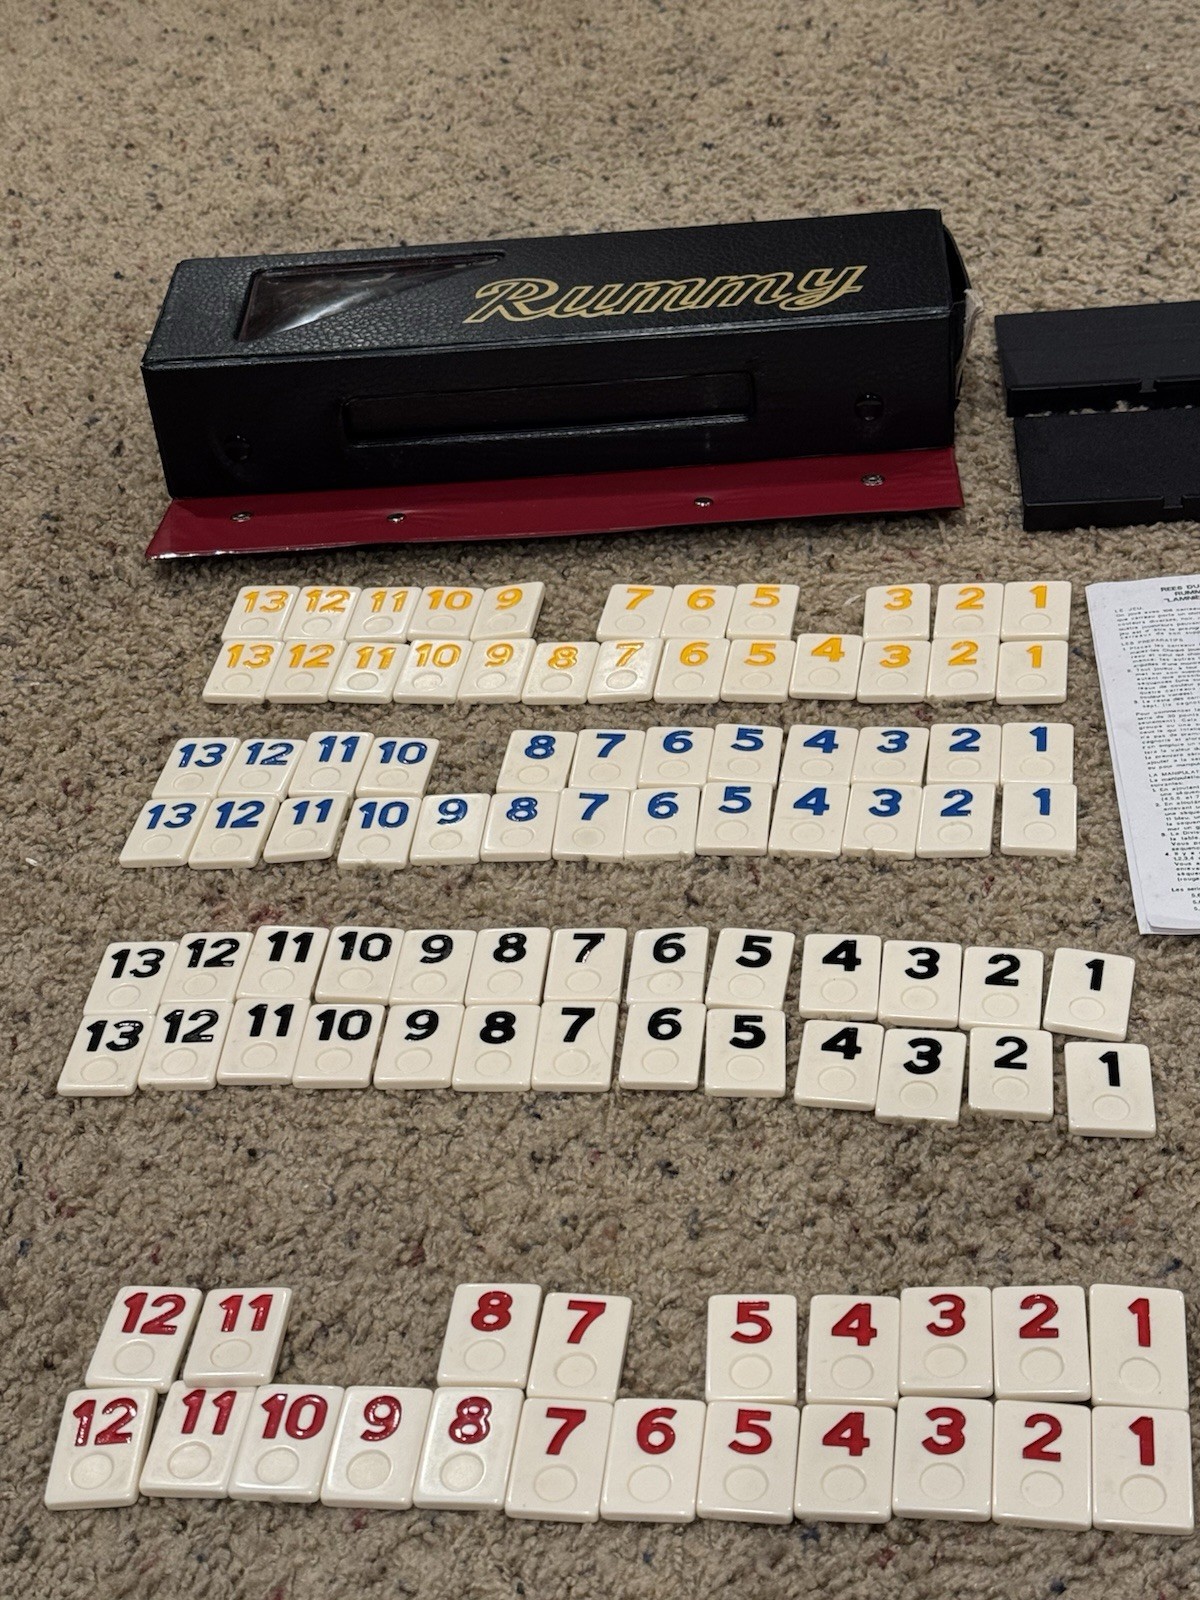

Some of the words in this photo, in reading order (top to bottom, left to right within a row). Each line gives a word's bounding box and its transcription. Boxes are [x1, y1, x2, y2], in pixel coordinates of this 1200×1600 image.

[463, 265, 867, 323] Rummy
[243, 590, 287, 612] 13
[305, 589, 350, 613] 12
[371, 591, 407, 611] 11
[427, 589, 473, 610] 10
[497, 588, 523, 610] 9
[626, 588, 654, 610] 7
[687, 588, 715, 611] 6
[750, 587, 780, 608] 5
[885, 588, 913, 611] 3
[956, 587, 985, 610] 2
[1031, 585, 1048, 609] 1
[228, 644, 274, 669] 13
[288, 643, 335, 669] 12
[356, 646, 394, 669] 11
[416, 643, 461, 667] 10
[485, 643, 514, 667] 9
[547, 646, 577, 669] 8
[615, 642, 644, 667] 7
[679, 642, 709, 667] 6
[745, 643, 776, 667] 5
[811, 637, 845, 662] 4
[880, 645, 912, 669] 3
[948, 641, 979, 666] 2
[1027, 645, 1043, 668] 1
[247, 742, 294, 765] 12
[319, 735, 360, 762] 11
[379, 741, 427, 764] 10
[524, 735, 556, 759] 8
[597, 733, 626, 758] 7
[663, 730, 693, 753] 6
[731, 727, 764, 751] 5
[803, 729, 838, 753] 4
[878, 730, 909, 753] 3
[949, 728, 981, 752] 2
[1029, 726, 1047, 752] 1
[179, 743, 227, 767] 13
[216, 800, 265, 828] 12
[293, 798, 333, 825] 11
[437, 798, 468, 824] 9
[506, 797, 538, 822] 8
[579, 792, 609, 820] 7
[647, 791, 678, 819] 6
[719, 786, 751, 813] 5
[793, 787, 830, 816] 4
[869, 788, 902, 817] 3
[940, 789, 973, 817] 2
[1033, 788, 1051, 816] 1
[147, 803, 197, 829] 13
[359, 801, 409, 829] 10
[186, 938, 240, 968] 12
[267, 930, 315, 964] 11
[338, 931, 393, 962] 10
[419, 934, 454, 964] 9
[492, 932, 527, 964] 8
[573, 932, 606, 963] 7
[652, 932, 686, 964] 6
[735, 934, 773, 968] 5
[822, 939, 862, 972] 4
[111, 948, 165, 979] 13
[904, 946, 940, 980] 3
[984, 953, 1021, 987] 2
[1085, 958, 1105, 992] 1
[163, 1009, 219, 1044] 12
[248, 1003, 295, 1037] 11
[315, 1009, 373, 1041] 10
[404, 1009, 439, 1041] 9
[479, 1010, 517, 1045] 8
[561, 1007, 596, 1043] 7
[647, 1007, 682, 1041] 6
[729, 1014, 766, 1050] 5
[86, 1020, 144, 1052] 13
[820, 1026, 863, 1061] 4
[903, 1037, 943, 1075] 3
[994, 1036, 1028, 1070] 2
[1098, 1050, 1121, 1087] 1
[122, 1292, 186, 1335] 12
[219, 1294, 273, 1332] 11
[470, 1290, 513, 1332] 8
[567, 1300, 606, 1344] 7
[731, 1301, 773, 1344] 5
[831, 1303, 877, 1347] 4
[926, 1294, 966, 1337] 3
[1019, 1294, 1059, 1339] 2
[1128, 1297, 1151, 1347] 1
[73, 1397, 138, 1445] 12
[181, 1388, 237, 1435] 11
[262, 1393, 328, 1440] 10
[361, 1395, 402, 1441] 9
[448, 1396, 492, 1444] 8
[546, 1407, 586, 1455] 7
[636, 1407, 677, 1455] 6
[728, 1408, 772, 1455] 5
[822, 1411, 870, 1456] 4
[922, 1407, 966, 1455] 3
[1022, 1413, 1062, 1462] 2
[1129, 1416, 1155, 1466] 1
